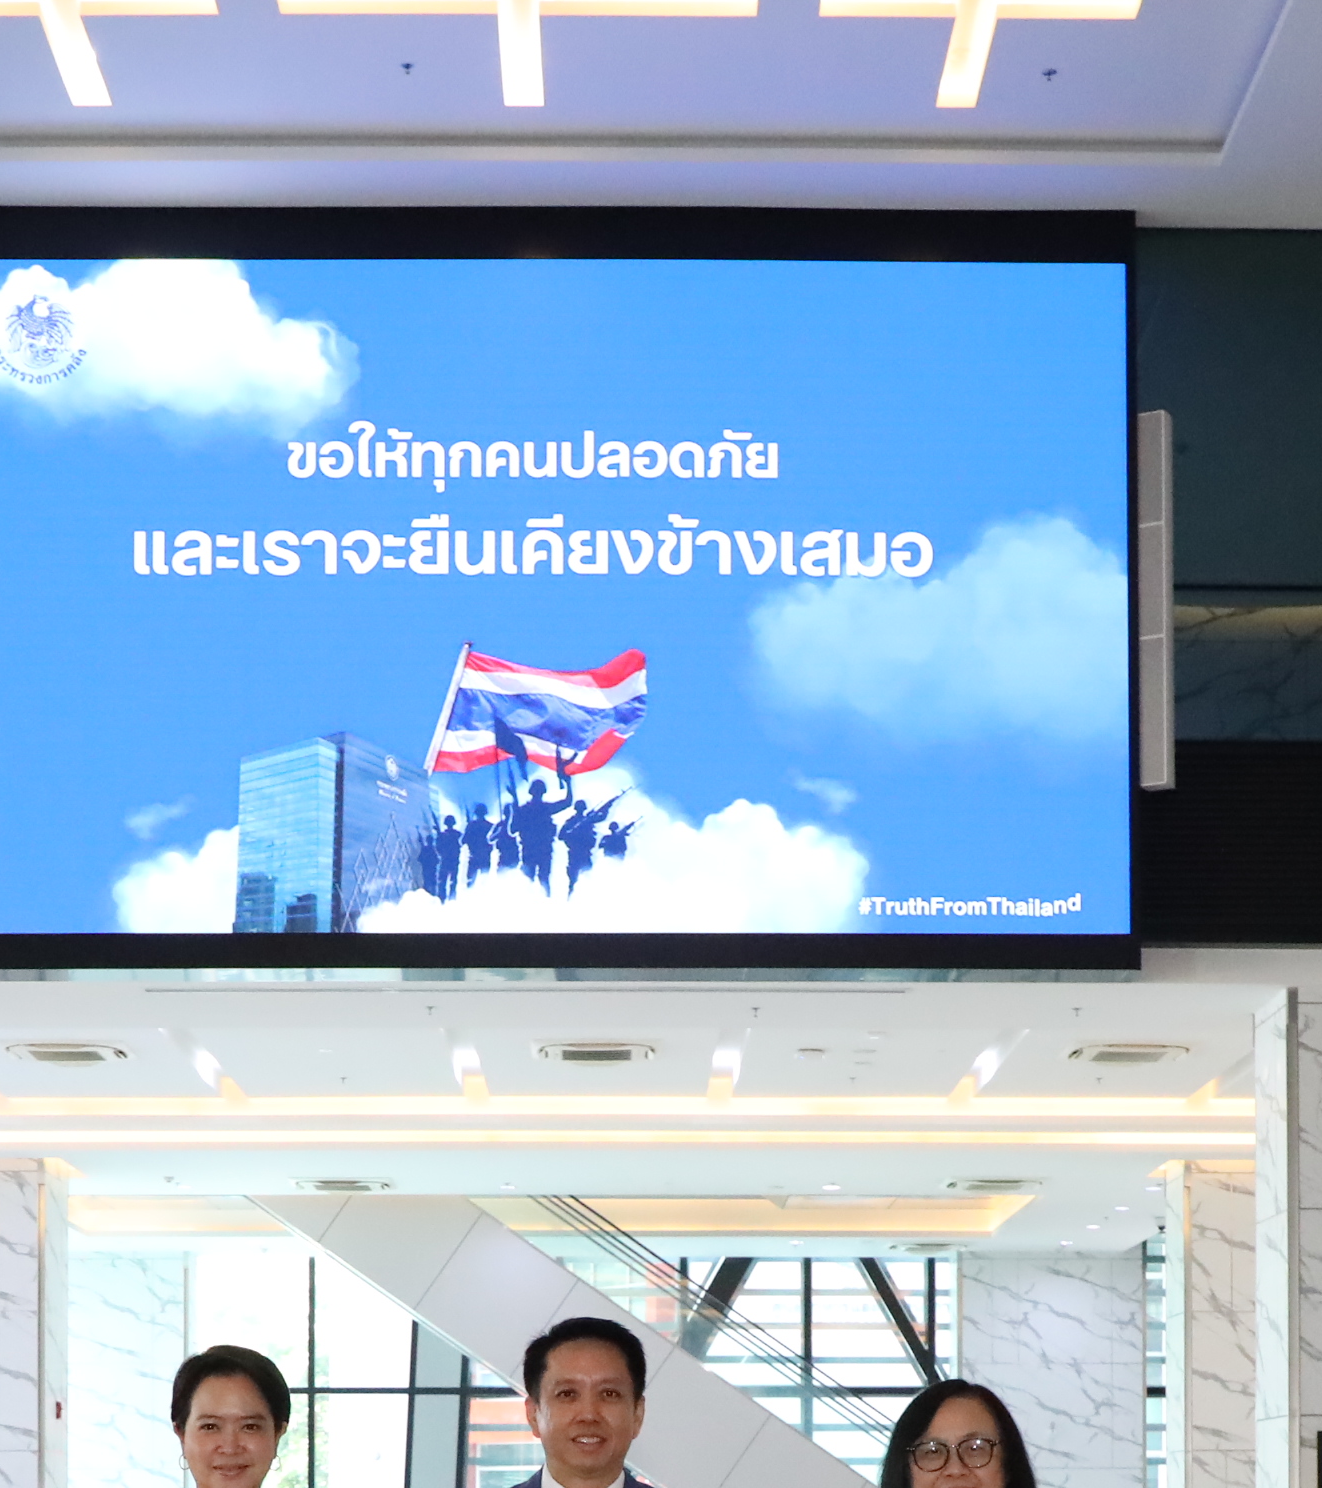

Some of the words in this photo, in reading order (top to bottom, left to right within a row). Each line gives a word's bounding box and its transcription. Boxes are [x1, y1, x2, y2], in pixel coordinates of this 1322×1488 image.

[285, 421, 780, 493] ขอให้ทุกคนปลอดภัย
[131, 512, 935, 578] และเราจะยืนเคียงข้างเสมอ
[858, 893, 1082, 918] #TruthFromThailand
